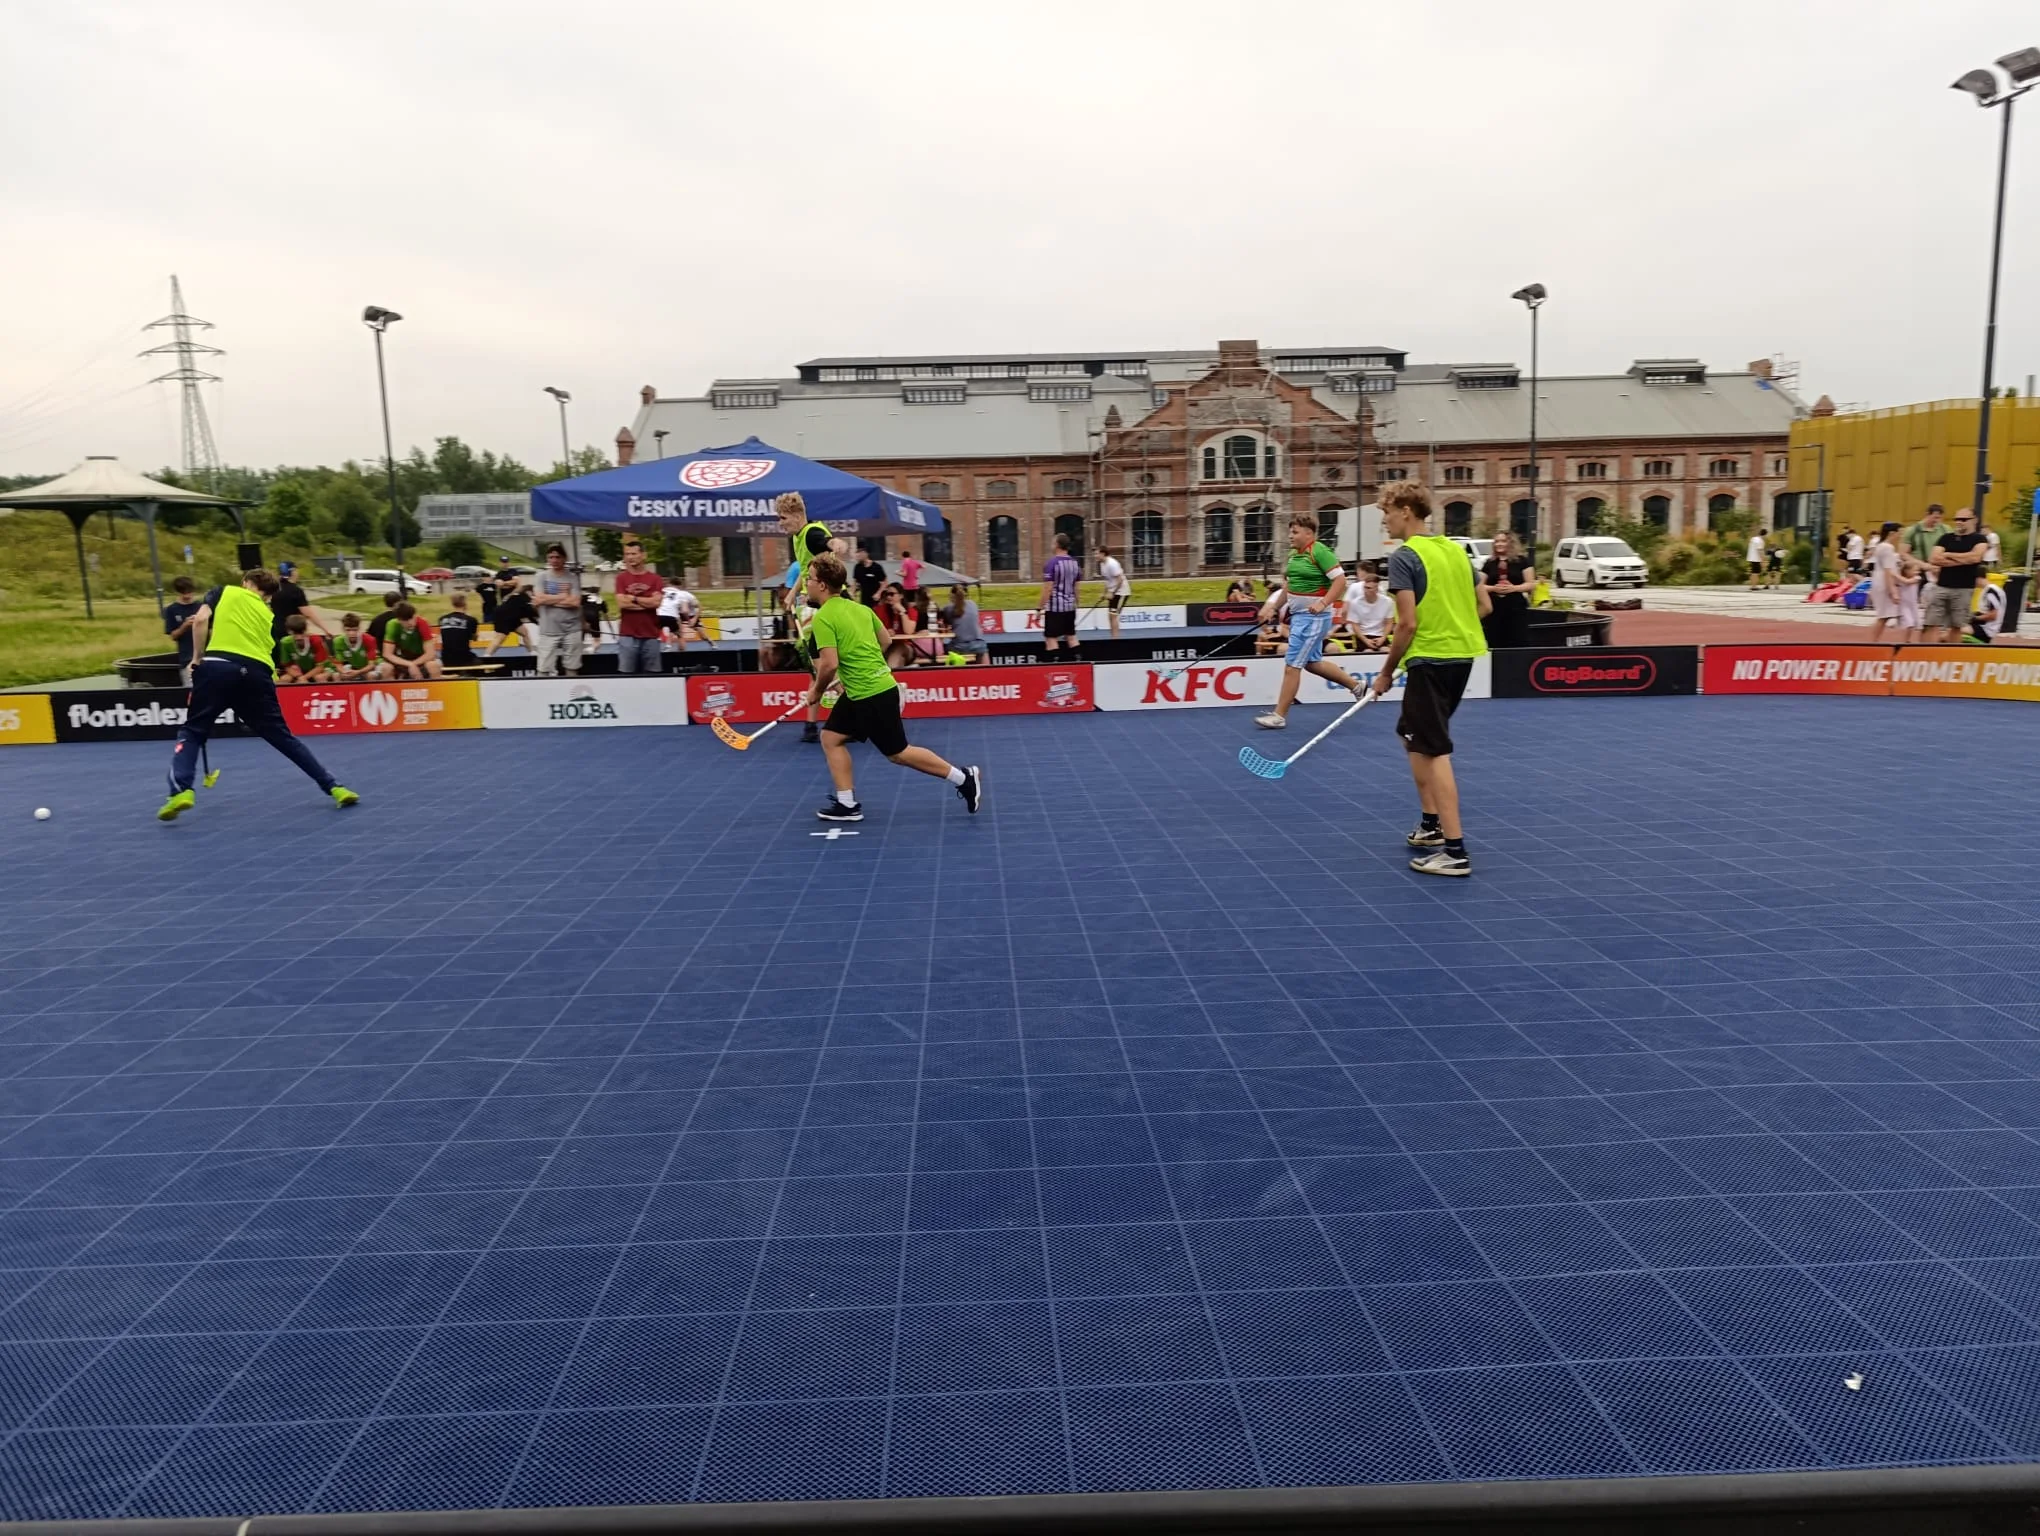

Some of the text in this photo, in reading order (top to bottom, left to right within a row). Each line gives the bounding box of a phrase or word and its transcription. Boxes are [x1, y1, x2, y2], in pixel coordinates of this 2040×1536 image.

[628, 496, 691, 517] ČESKÝ
[1544, 666, 1640, 684] BigBoard
[1732, 659, 1763, 681] NO
[1763, 659, 1841, 681] POWER
[1841, 660, 1891, 682] LIKE
[1891, 661, 1980, 683] WOMEN
[761, 690, 796, 706] KFC
[959, 684, 1021, 702] LEAGUE
[1139, 666, 1248, 704] KFC
[549, 702, 618, 720] HOLBA
